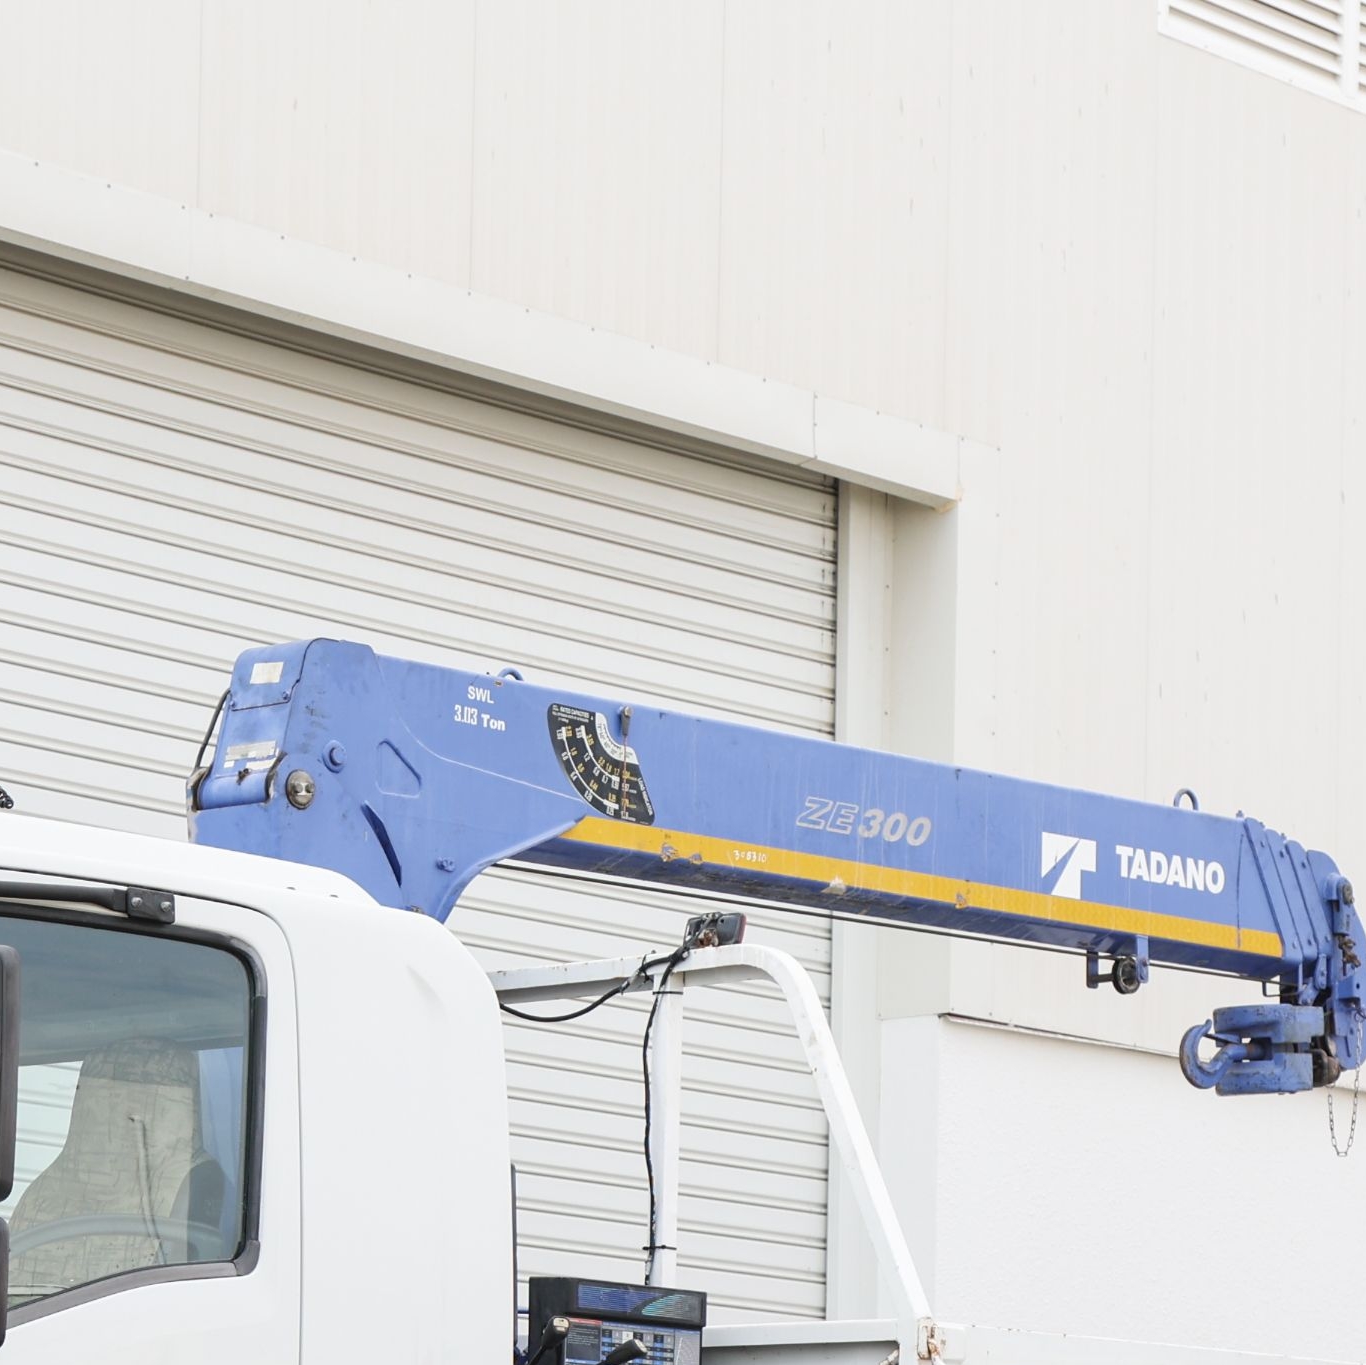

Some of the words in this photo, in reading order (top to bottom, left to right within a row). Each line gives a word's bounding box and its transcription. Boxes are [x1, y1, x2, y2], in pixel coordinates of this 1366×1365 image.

[467, 685, 494, 704] SWL
[481, 713, 506, 731] Ton
[796, 796, 932, 846] ZE300
[1115, 844, 1226, 895] TADANO
